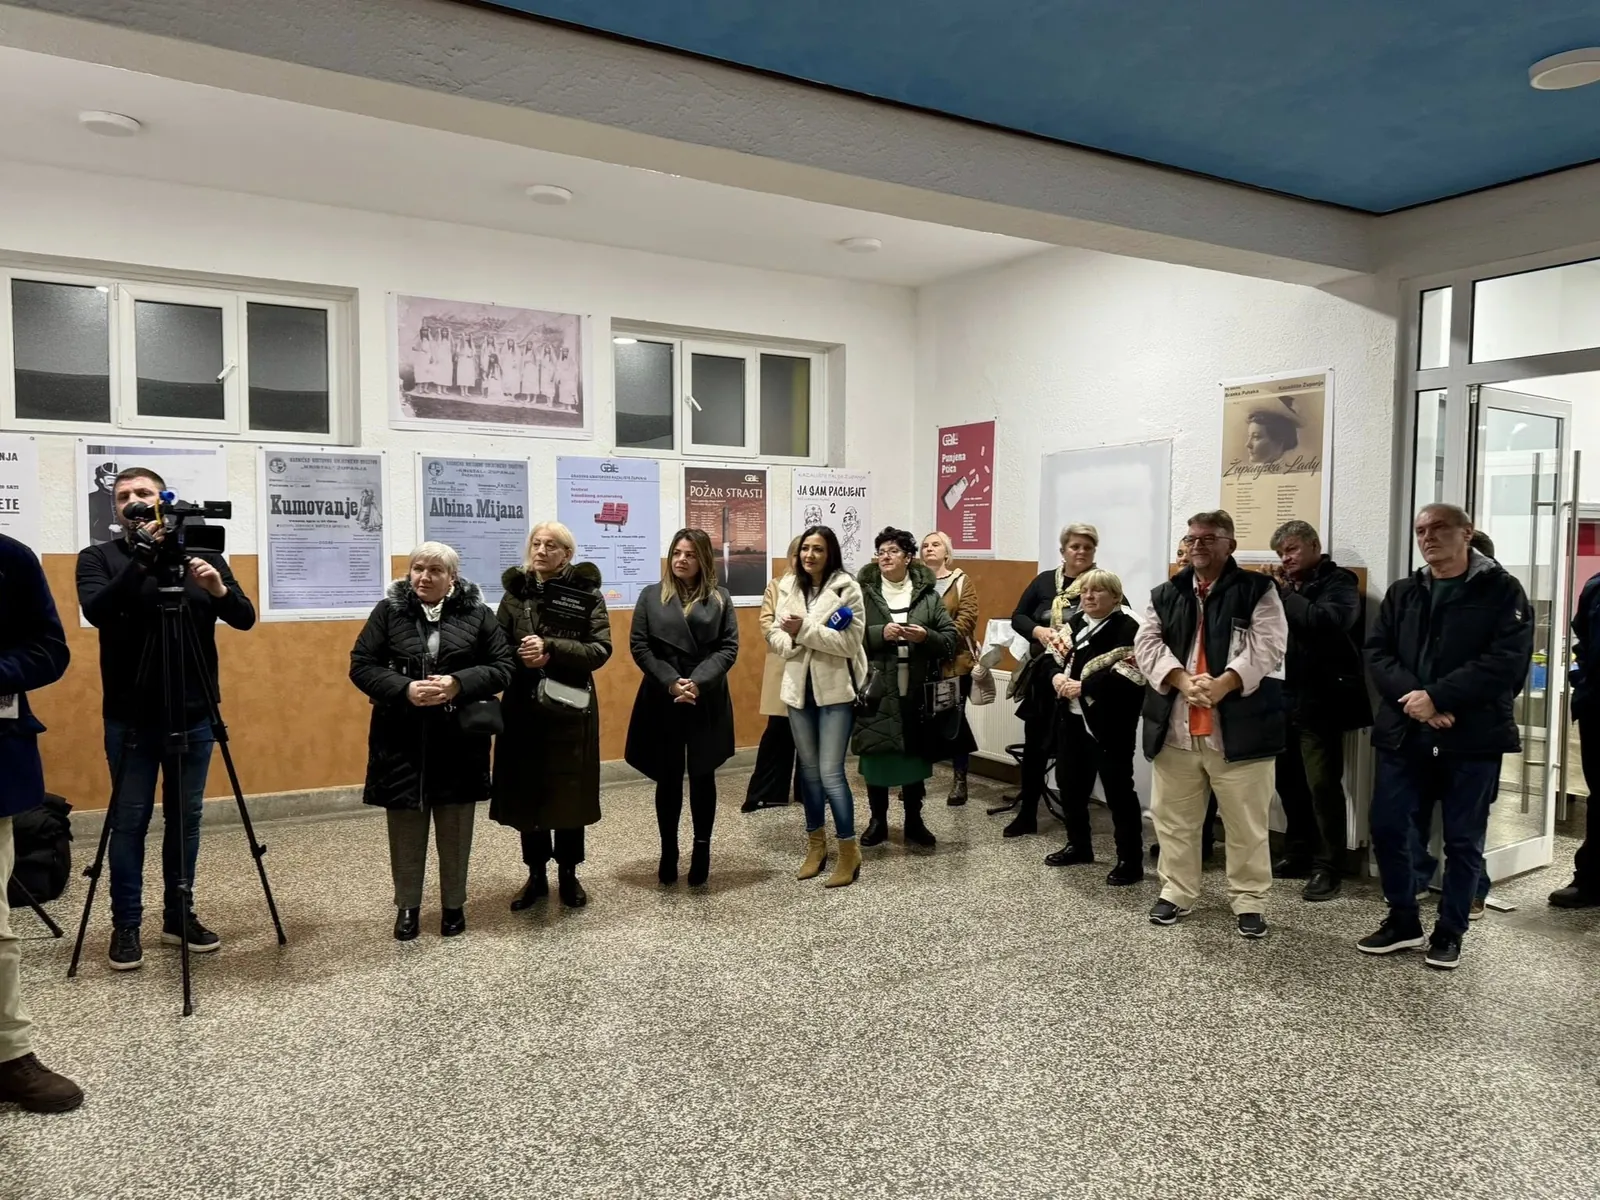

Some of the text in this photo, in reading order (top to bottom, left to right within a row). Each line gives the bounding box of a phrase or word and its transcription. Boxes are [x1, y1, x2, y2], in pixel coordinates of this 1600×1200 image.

[1223, 455, 1320, 480] Županjska Lady
[690, 484, 763, 499] POŽAR STRASTI
[797, 485, 867, 497] JA SAM PACIJENT
[270, 494, 358, 519] Kumovanje
[429, 497, 524, 521] Albina Mijana
[830, 502, 836, 513] 2
